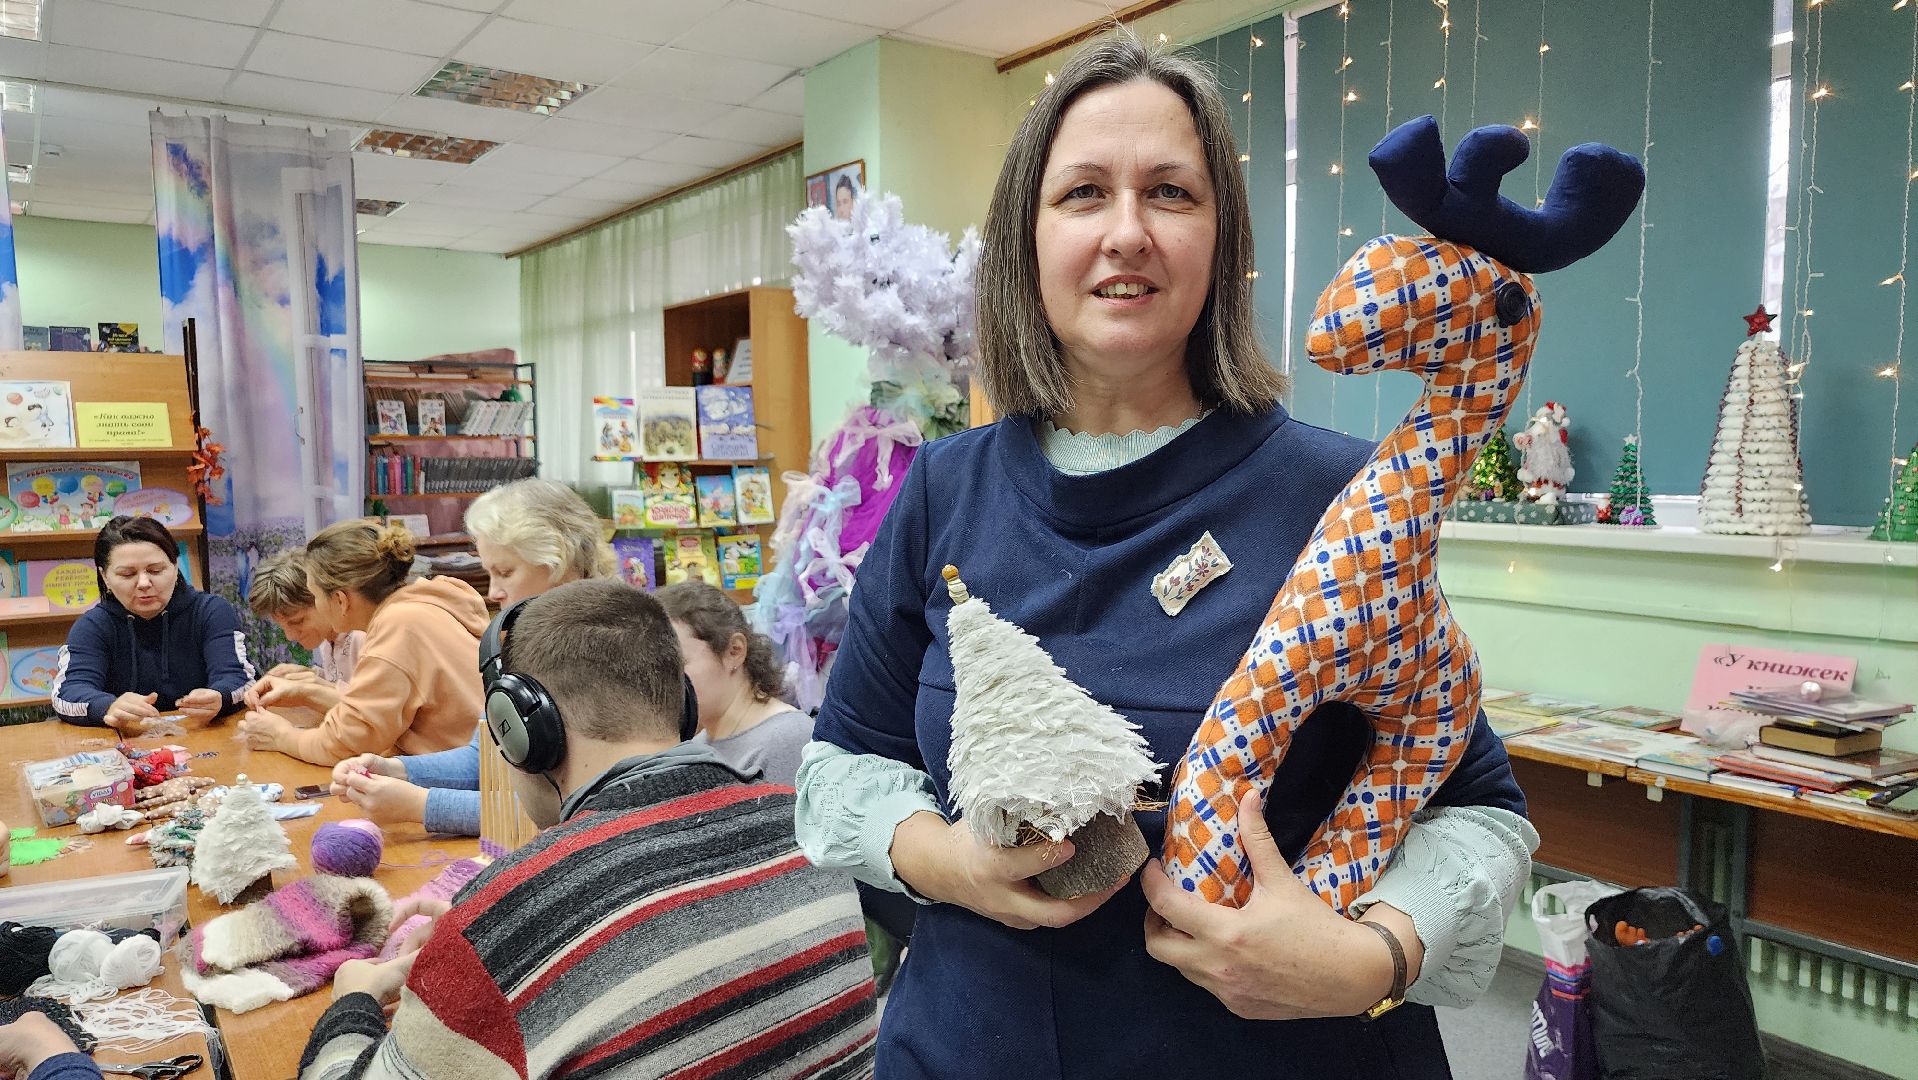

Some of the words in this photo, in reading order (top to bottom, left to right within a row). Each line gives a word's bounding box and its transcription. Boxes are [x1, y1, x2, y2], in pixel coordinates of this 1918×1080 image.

[1713, 653, 1745, 667] «У
[1747, 659, 1849, 682] книжек
[92, 788, 111, 798] VIDAL
